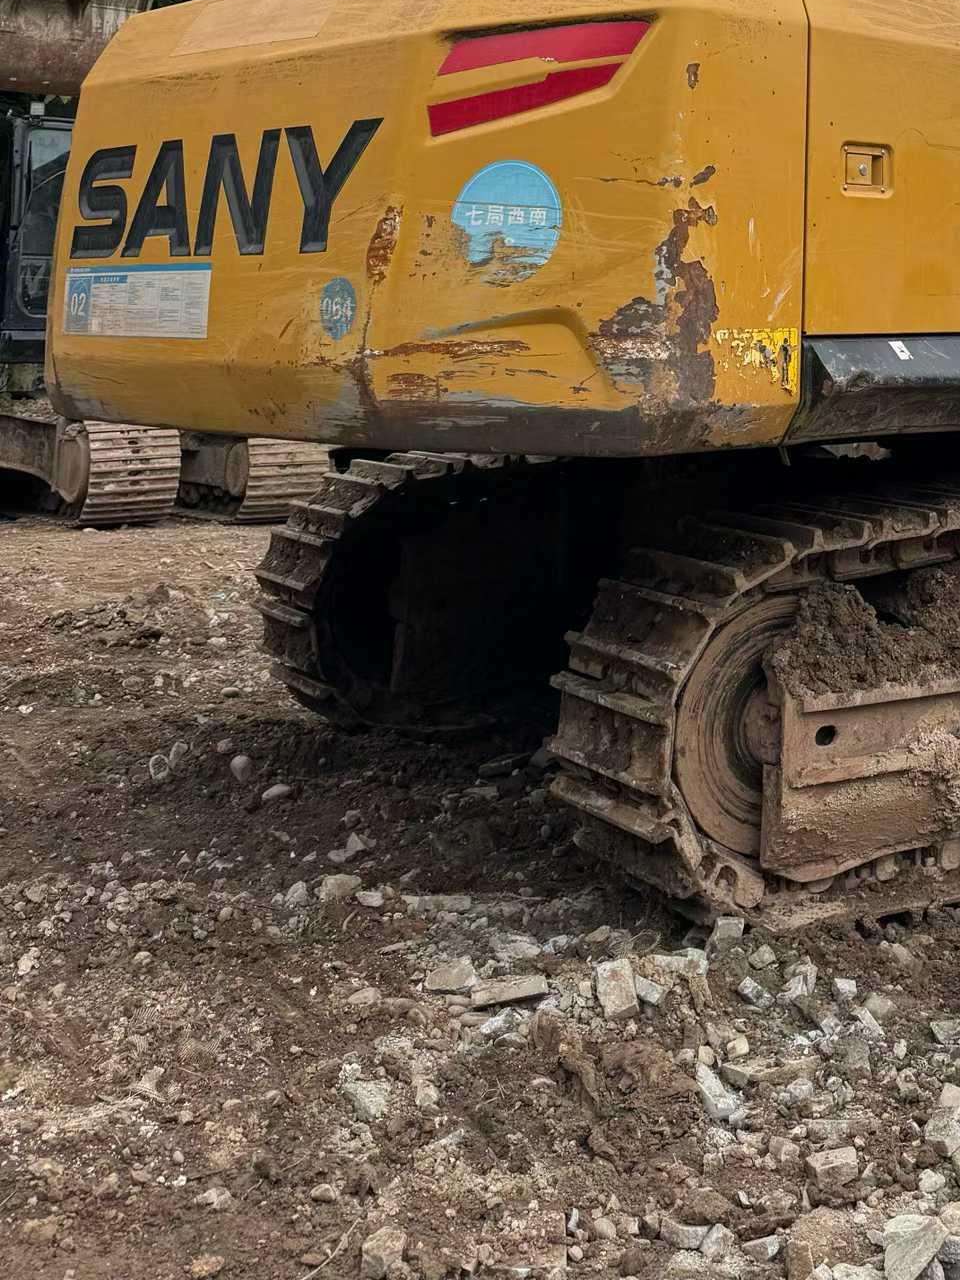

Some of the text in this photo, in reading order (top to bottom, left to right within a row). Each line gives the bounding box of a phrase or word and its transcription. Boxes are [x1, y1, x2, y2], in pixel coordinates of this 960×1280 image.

[70, 117, 384, 260] SANY
[464, 204, 547, 226] 七局西南
[70, 292, 87, 317] 02
